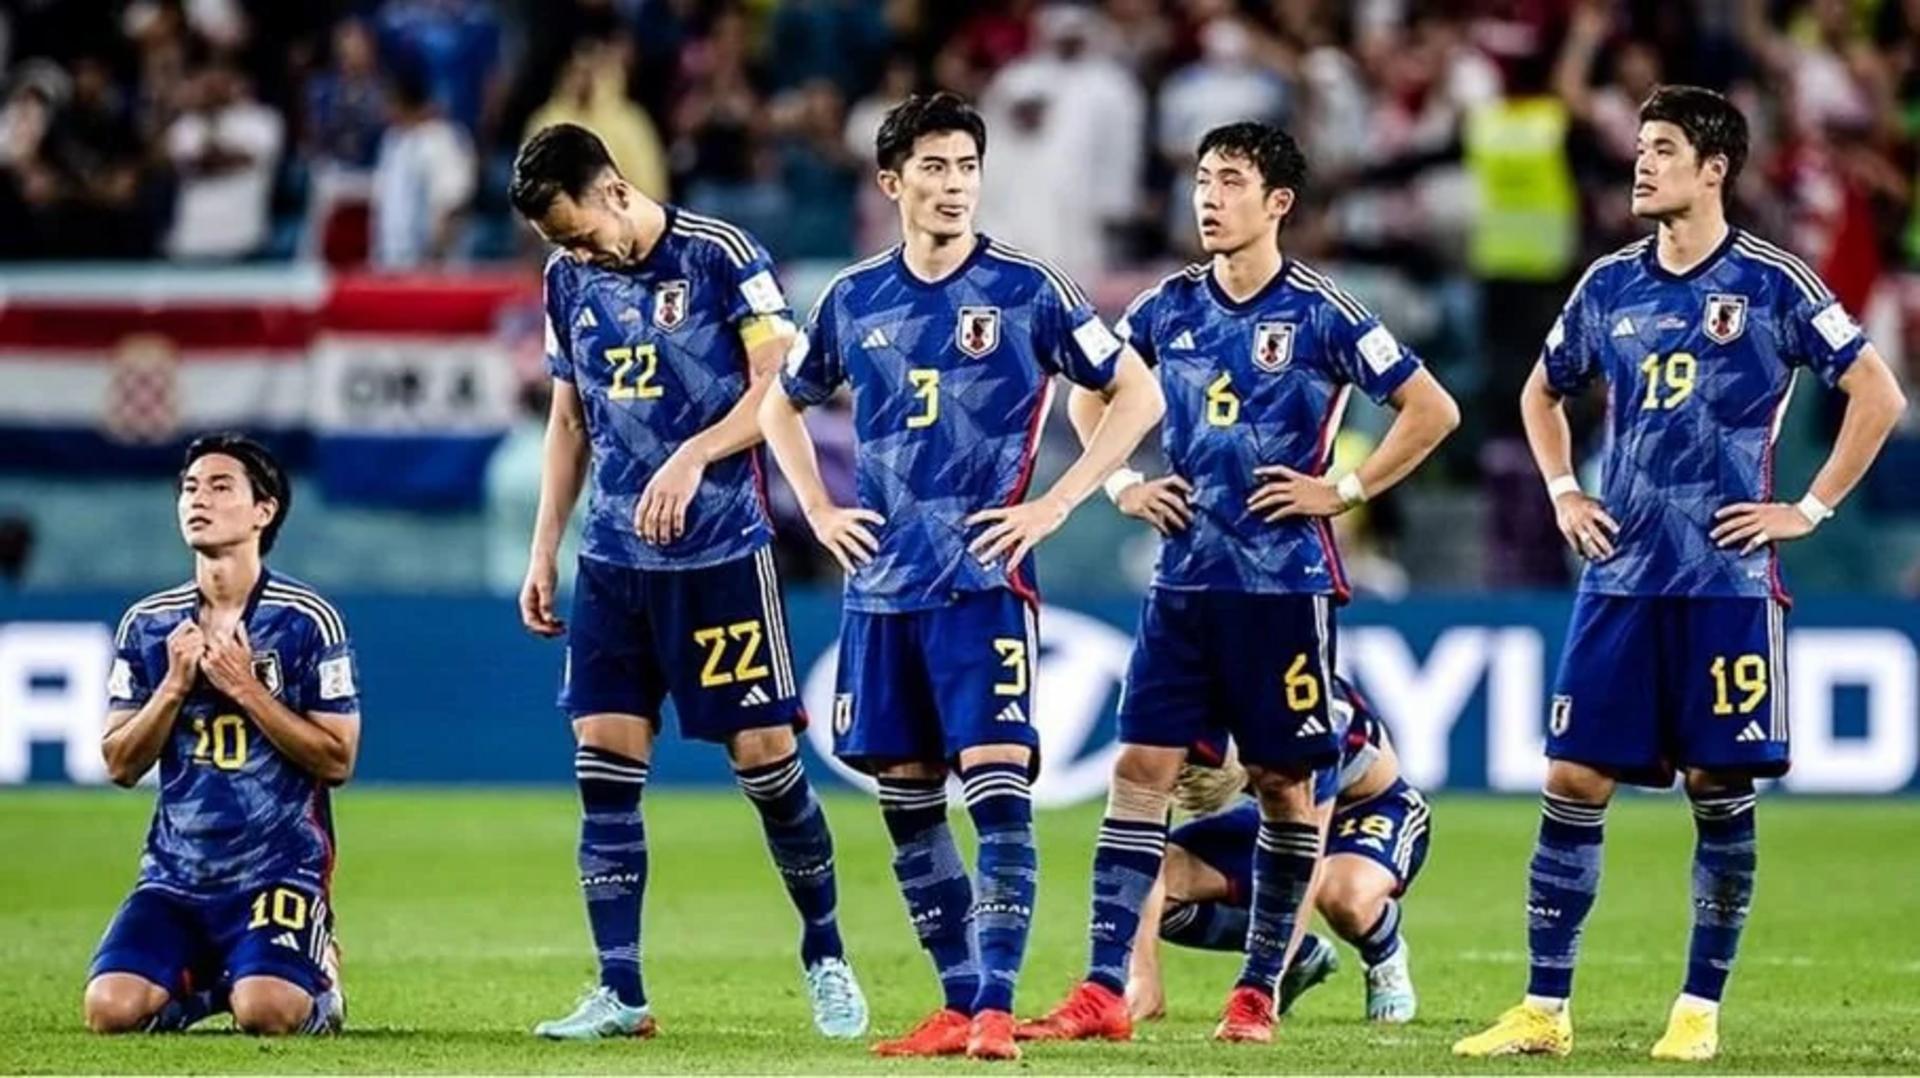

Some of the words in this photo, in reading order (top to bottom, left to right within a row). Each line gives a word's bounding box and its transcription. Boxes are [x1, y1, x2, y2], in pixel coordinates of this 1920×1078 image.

[605, 343, 664, 401] 22
[906, 368, 941, 428] 3
[1206, 372, 1240, 427] 6
[1641, 351, 1698, 411] 19
[693, 619, 770, 688] 22
[993, 637, 1027, 696] 3
[1283, 653, 1321, 712] 6
[1709, 653, 1768, 716] 19
[190, 714, 247, 770] 10
[248, 887, 307, 931] 10
